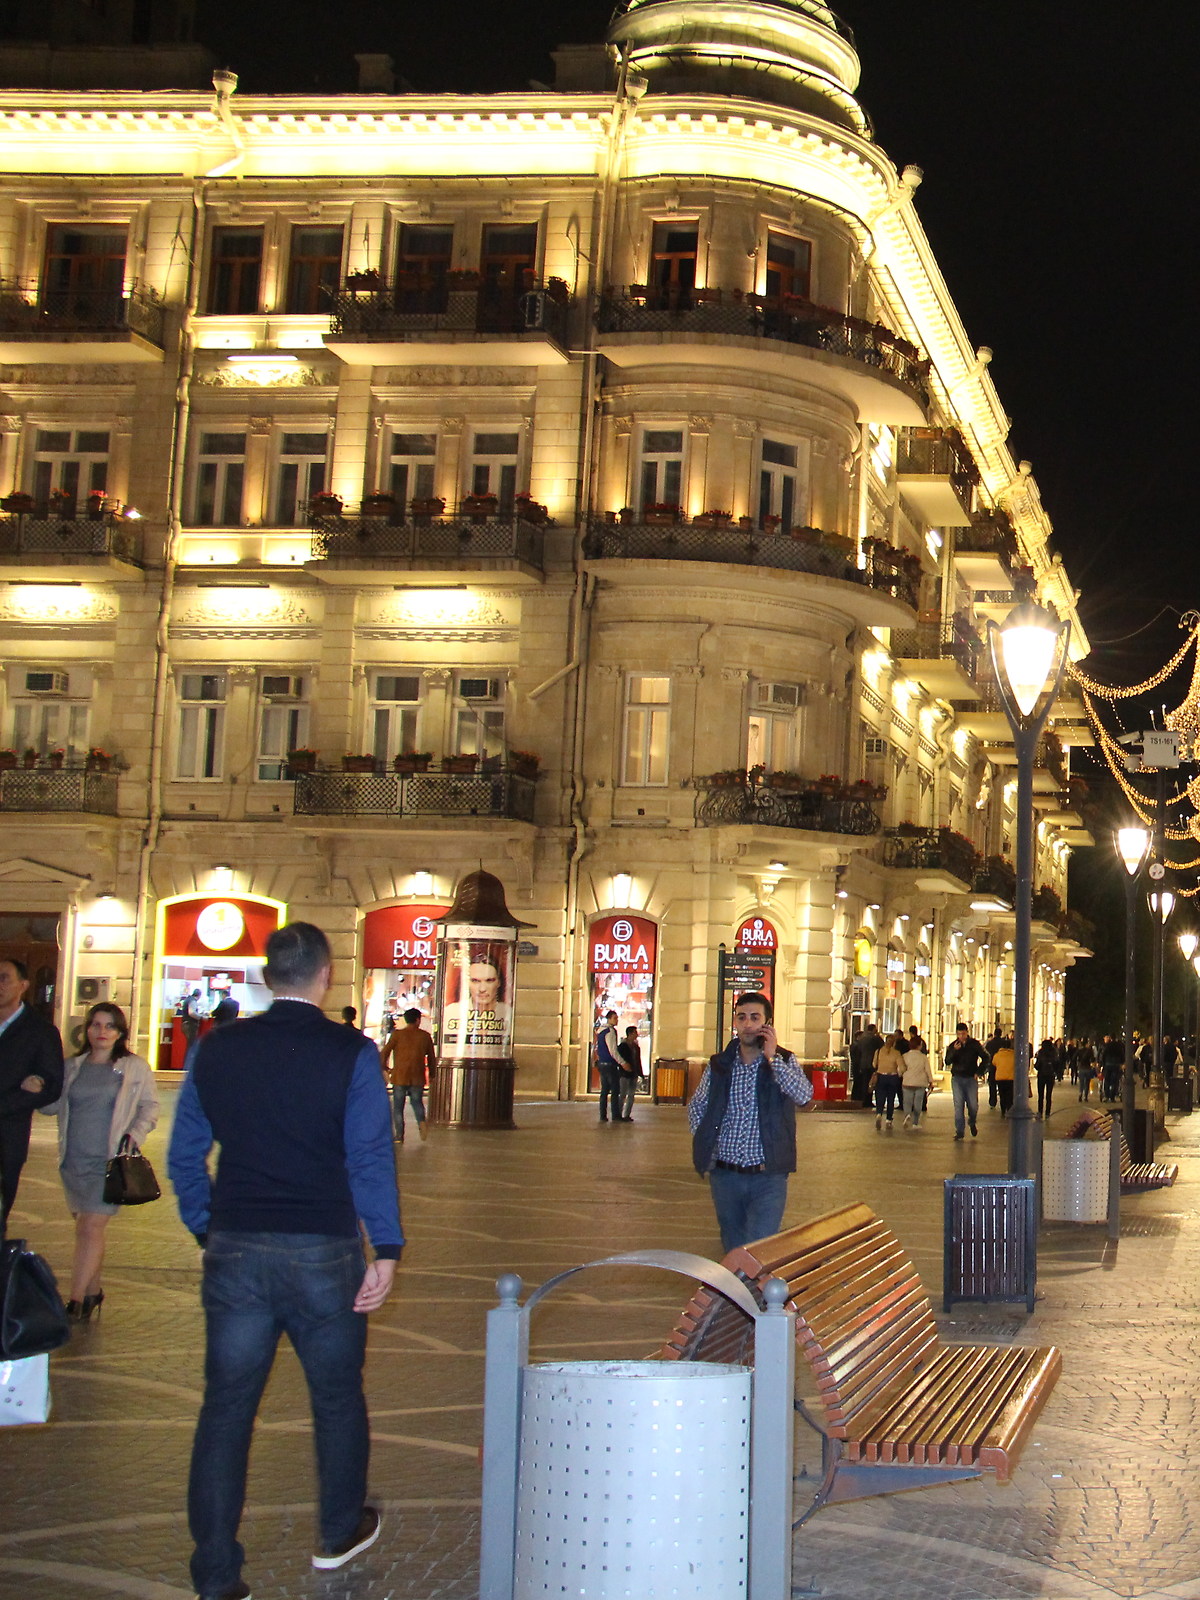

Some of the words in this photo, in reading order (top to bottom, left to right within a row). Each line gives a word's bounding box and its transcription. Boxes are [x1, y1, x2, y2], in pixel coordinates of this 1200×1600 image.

[742, 928, 773, 941] BURLA
[393, 940, 437, 958] BURL
[595, 944, 648, 962] BURLA
[468, 1010, 495, 1020] VLAD
